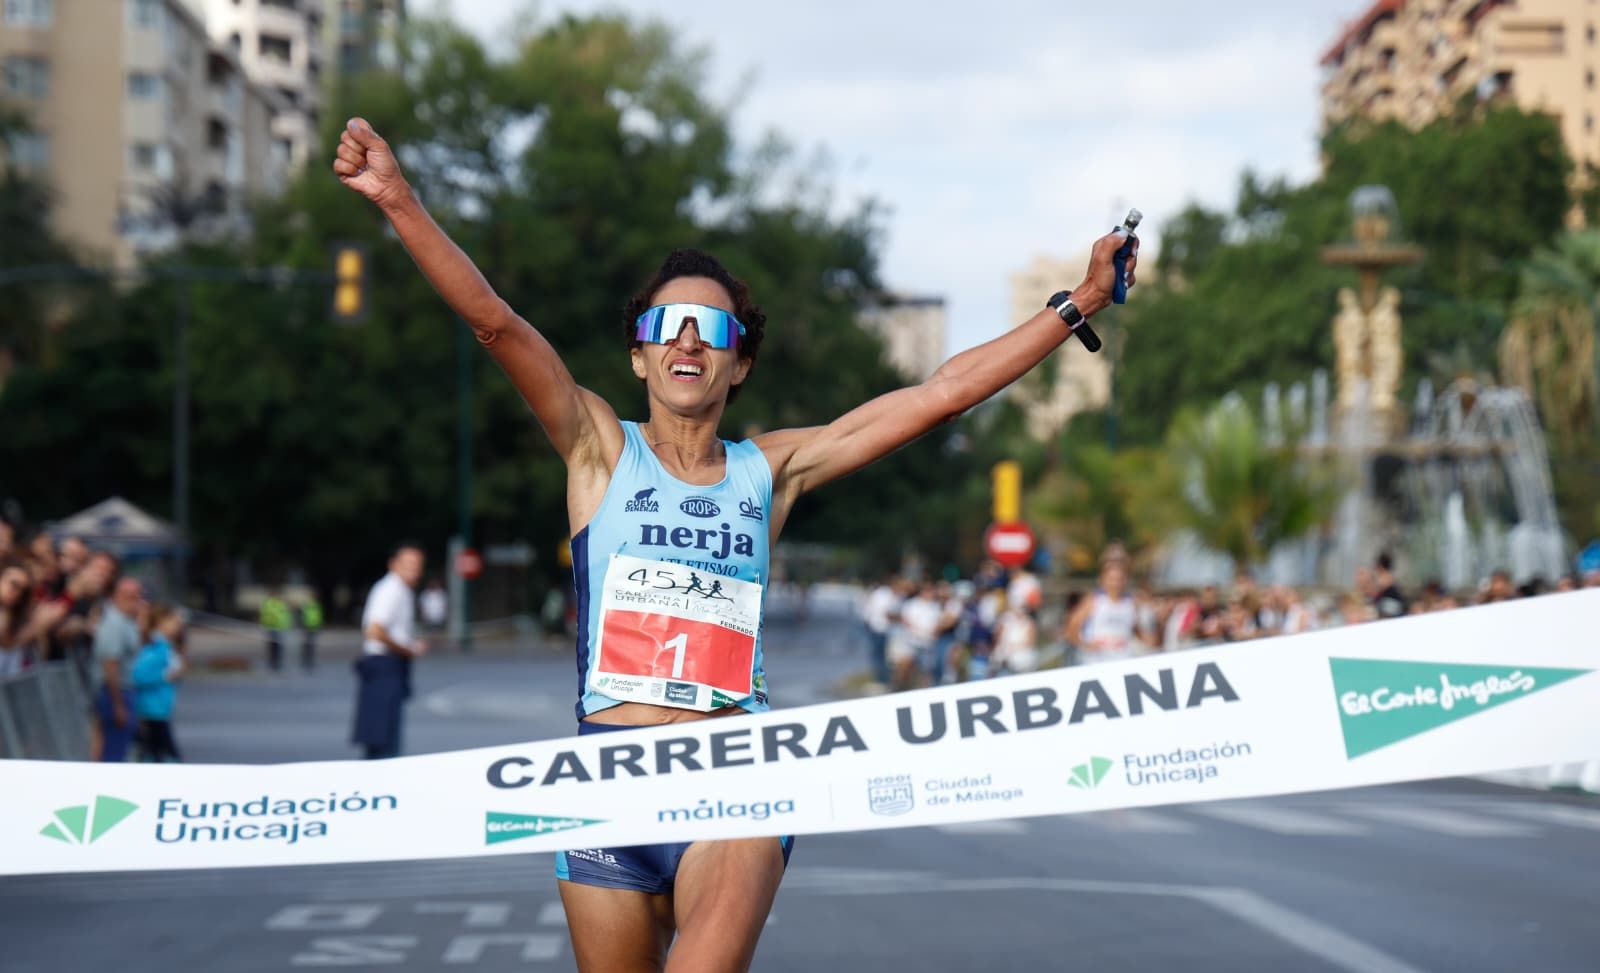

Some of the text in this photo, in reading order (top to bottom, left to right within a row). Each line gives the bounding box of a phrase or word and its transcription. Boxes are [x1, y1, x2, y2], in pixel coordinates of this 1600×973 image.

[681, 500, 720, 516] TROPS
[639, 523, 754, 559] nerja
[628, 568, 677, 589] 45
[660, 557, 738, 577] ETISMO
[615, 595, 681, 608] URBANA
[720, 620, 754, 635] FEDERADO
[664, 633, 688, 678] 1
[1340, 691, 1371, 716] El
[1371, 685, 1438, 711] Corte
[486, 661, 1240, 790] CARRERA URBANA
[1124, 741, 1251, 770] Fundación
[925, 774, 992, 791] Ciudad
[1126, 764, 1219, 787] Unicaja
[157, 791, 398, 819] Fundación
[927, 786, 1023, 806] de Málaga
[658, 798, 795, 823] málaga
[155, 817, 328, 844] Unicaja
